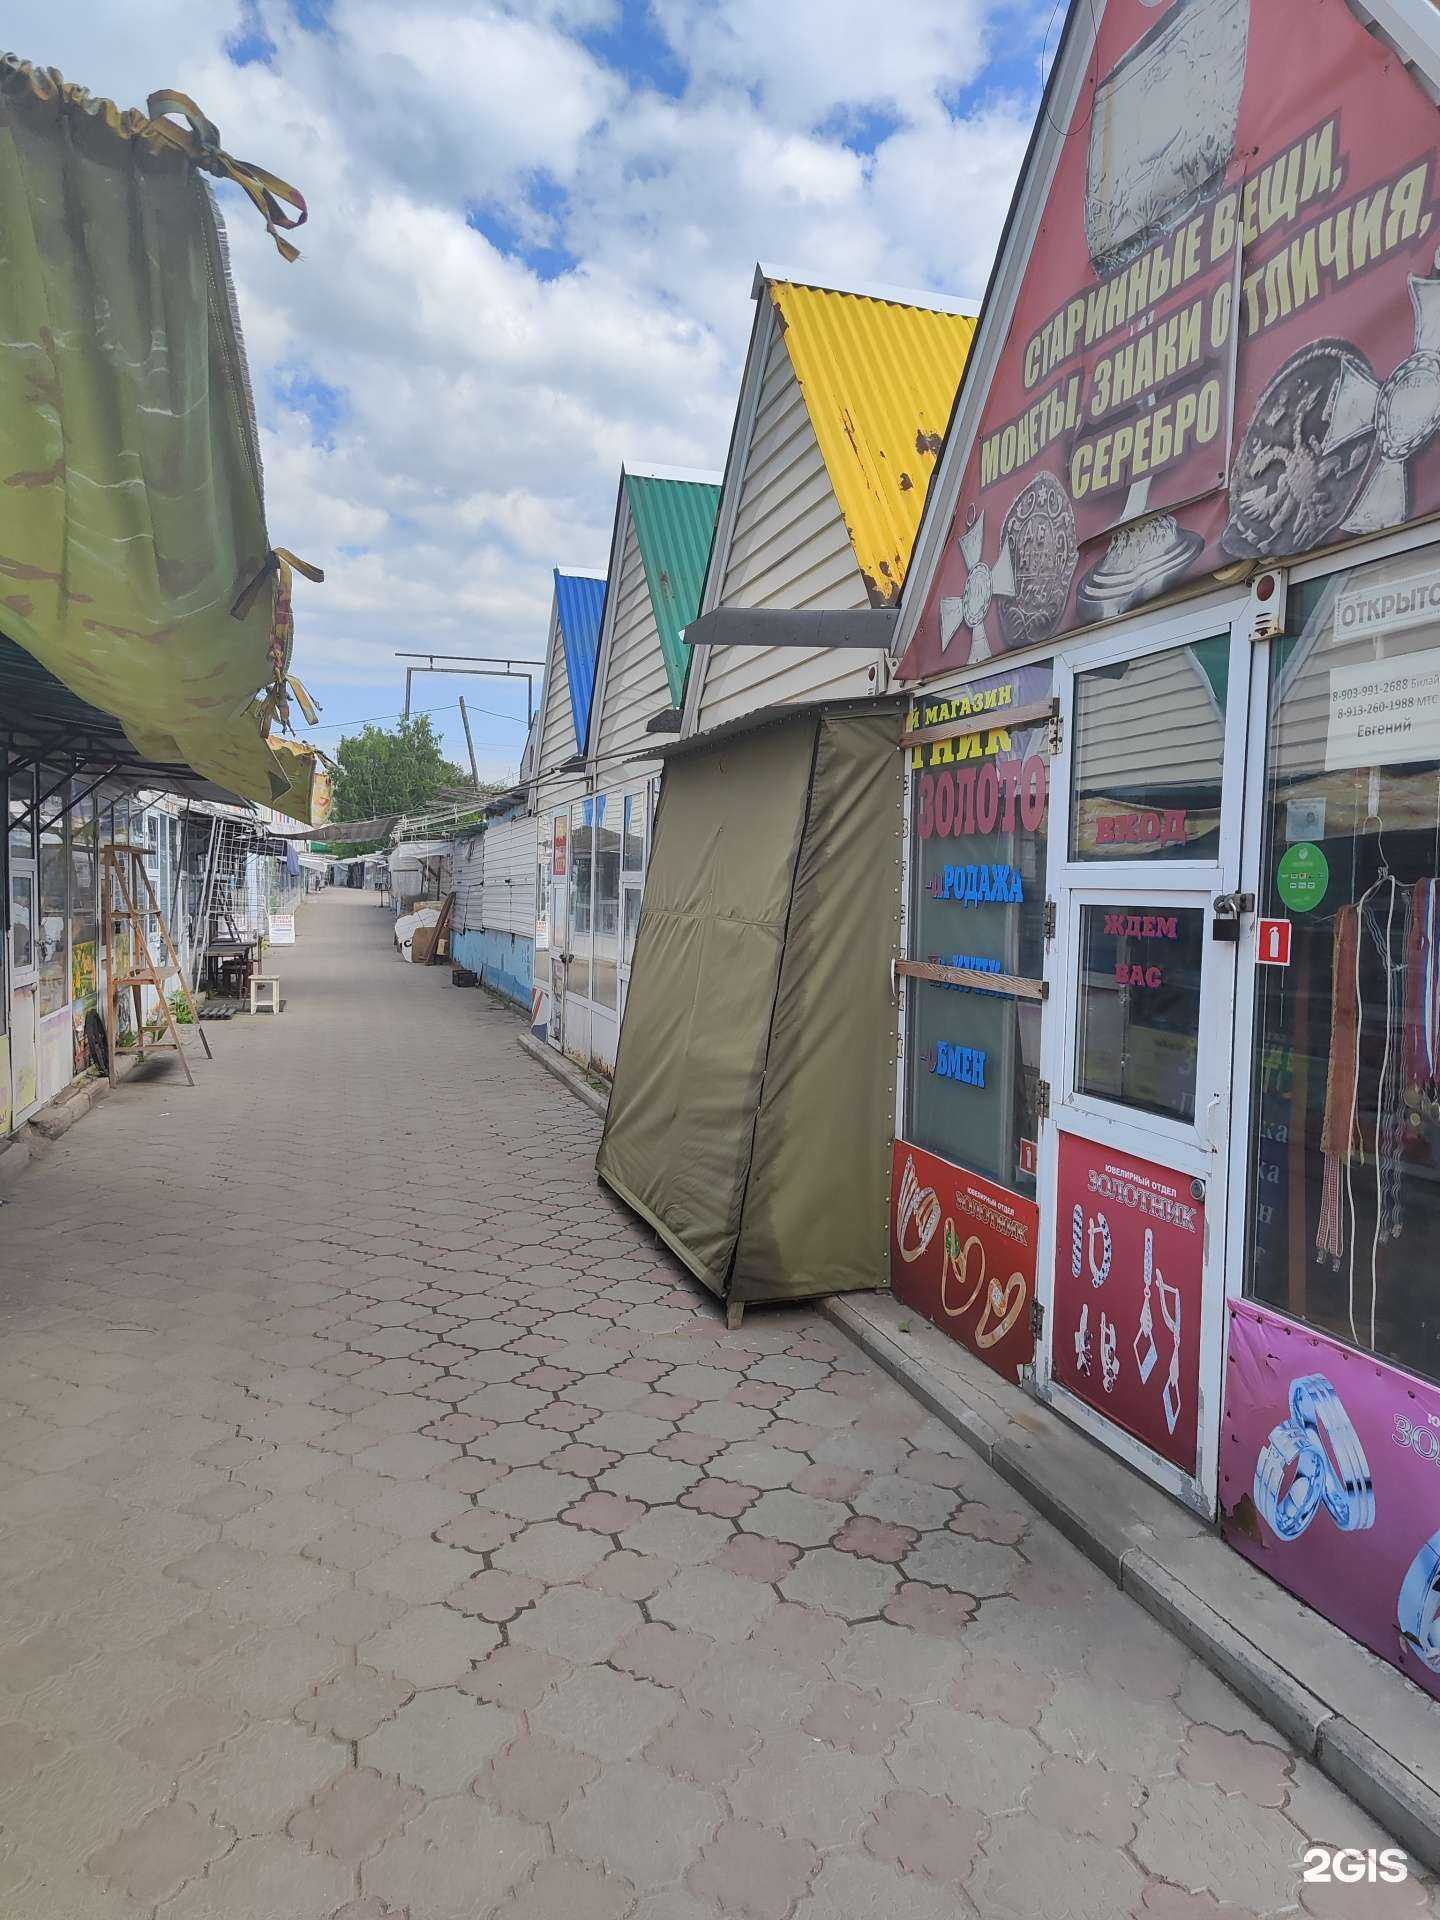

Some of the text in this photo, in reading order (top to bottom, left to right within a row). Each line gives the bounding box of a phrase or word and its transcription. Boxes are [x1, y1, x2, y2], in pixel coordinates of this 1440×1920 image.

[1024, 120, 1342, 389] СТАРИННЫЕ ВЕЩИ,
[981, 162, 1433, 488] МОНЕТЫ, ЗНАКИ ОТЛИЧИЯ,
[1071, 379, 1221, 500] СЕРЕБРО
[925, 684, 1012, 725] МАГАЗИН
[1332, 679, 1408, 702] 8-903-991-2688
[1337, 696, 1415, 719] 8-913-260-1988
[1357, 717, 1412, 738] Евгений
[918, 754, 1046, 838] ЗОЛОТО
[1104, 914, 1178, 940] ЖДЕМ
[1115, 963, 1163, 988] ВАС
[1105, 1164, 1177, 1198] ЮВЕЛИРНЫЙ ОТДЕЛ
[997, 1202, 1015, 1216] ОТДЕЛ
[1087, 1169, 1197, 1233] ЗОЛОТНИК
[1391, 1413, 1440, 1468] ЗО
